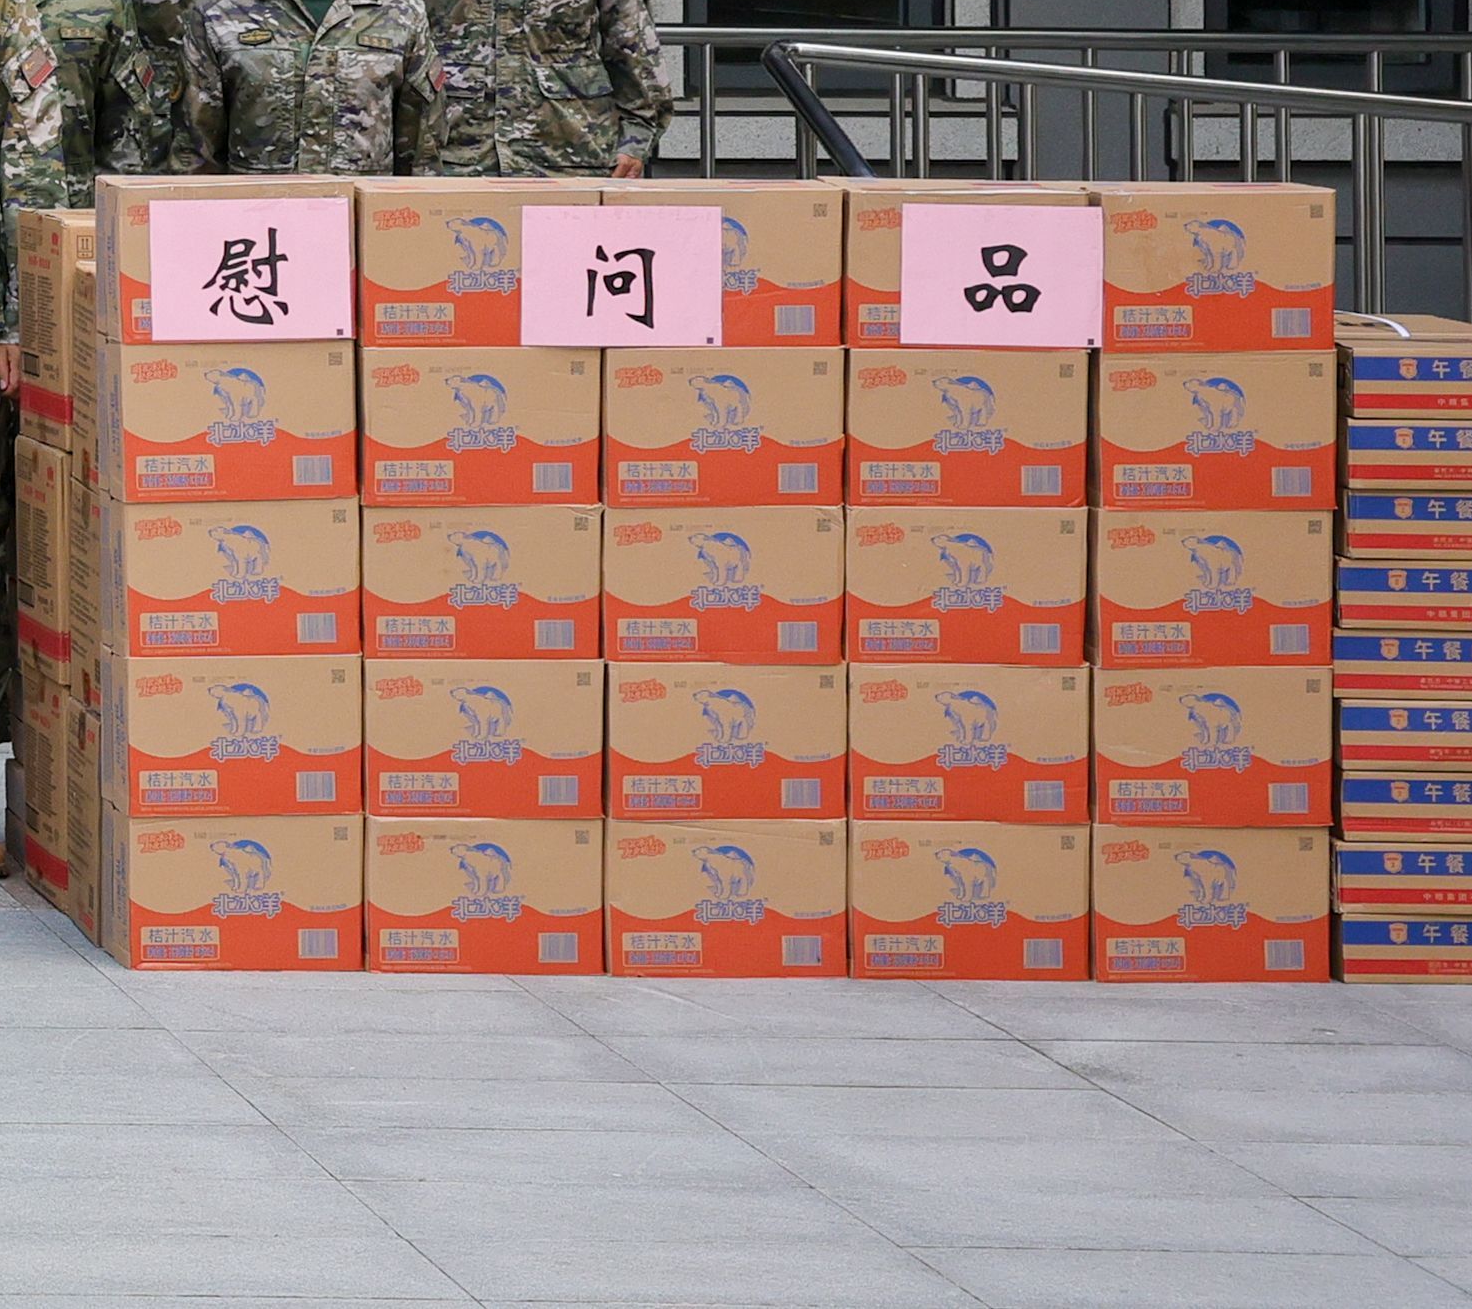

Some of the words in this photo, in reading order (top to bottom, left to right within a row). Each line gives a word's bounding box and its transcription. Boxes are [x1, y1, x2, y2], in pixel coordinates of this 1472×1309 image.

[202, 227, 289, 325] 慰
[447, 269, 516, 294] 北冰洋
[586, 245, 655, 329] 问
[964, 244, 1041, 313] 品
[1186, 271, 1256, 296] 北冰洋
[208, 420, 275, 445] 北冰洋
[447, 426, 516, 452] 北冰洋
[691, 426, 761, 452] 北冰洋
[933, 429, 1004, 454] 北冰洋
[1186, 430, 1256, 455] 北冰洋
[1428, 430, 1472, 448] 午餐
[1428, 500, 1472, 519] 午餐
[213, 577, 280, 602] 北冰洋
[1422, 572, 1470, 590] 午餐
[449, 582, 519, 607] 北冰洋
[690, 585, 760, 610] 北冰洋
[934, 586, 1003, 611] 北冰洋
[1184, 588, 1253, 613] 北冰洋
[1415, 641, 1462, 659] 午餐
[1424, 711, 1471, 730] 午餐
[211, 737, 280, 761] 北冰洋
[453, 738, 522, 764] 北冰洋
[695, 743, 764, 768] 北冰洋
[938, 745, 1007, 769] 北冰洋
[1181, 746, 1250, 771] 北冰洋
[1424, 783, 1472, 802] 午餐
[1418, 854, 1465, 873] 午餐
[213, 894, 282, 918] 北冰洋
[452, 895, 522, 920] 北冰洋
[696, 899, 764, 923] 北冰洋
[937, 901, 1007, 925] 北冰洋
[1178, 902, 1247, 929] 北冰洋
[1423, 924, 1470, 943] 午餐
